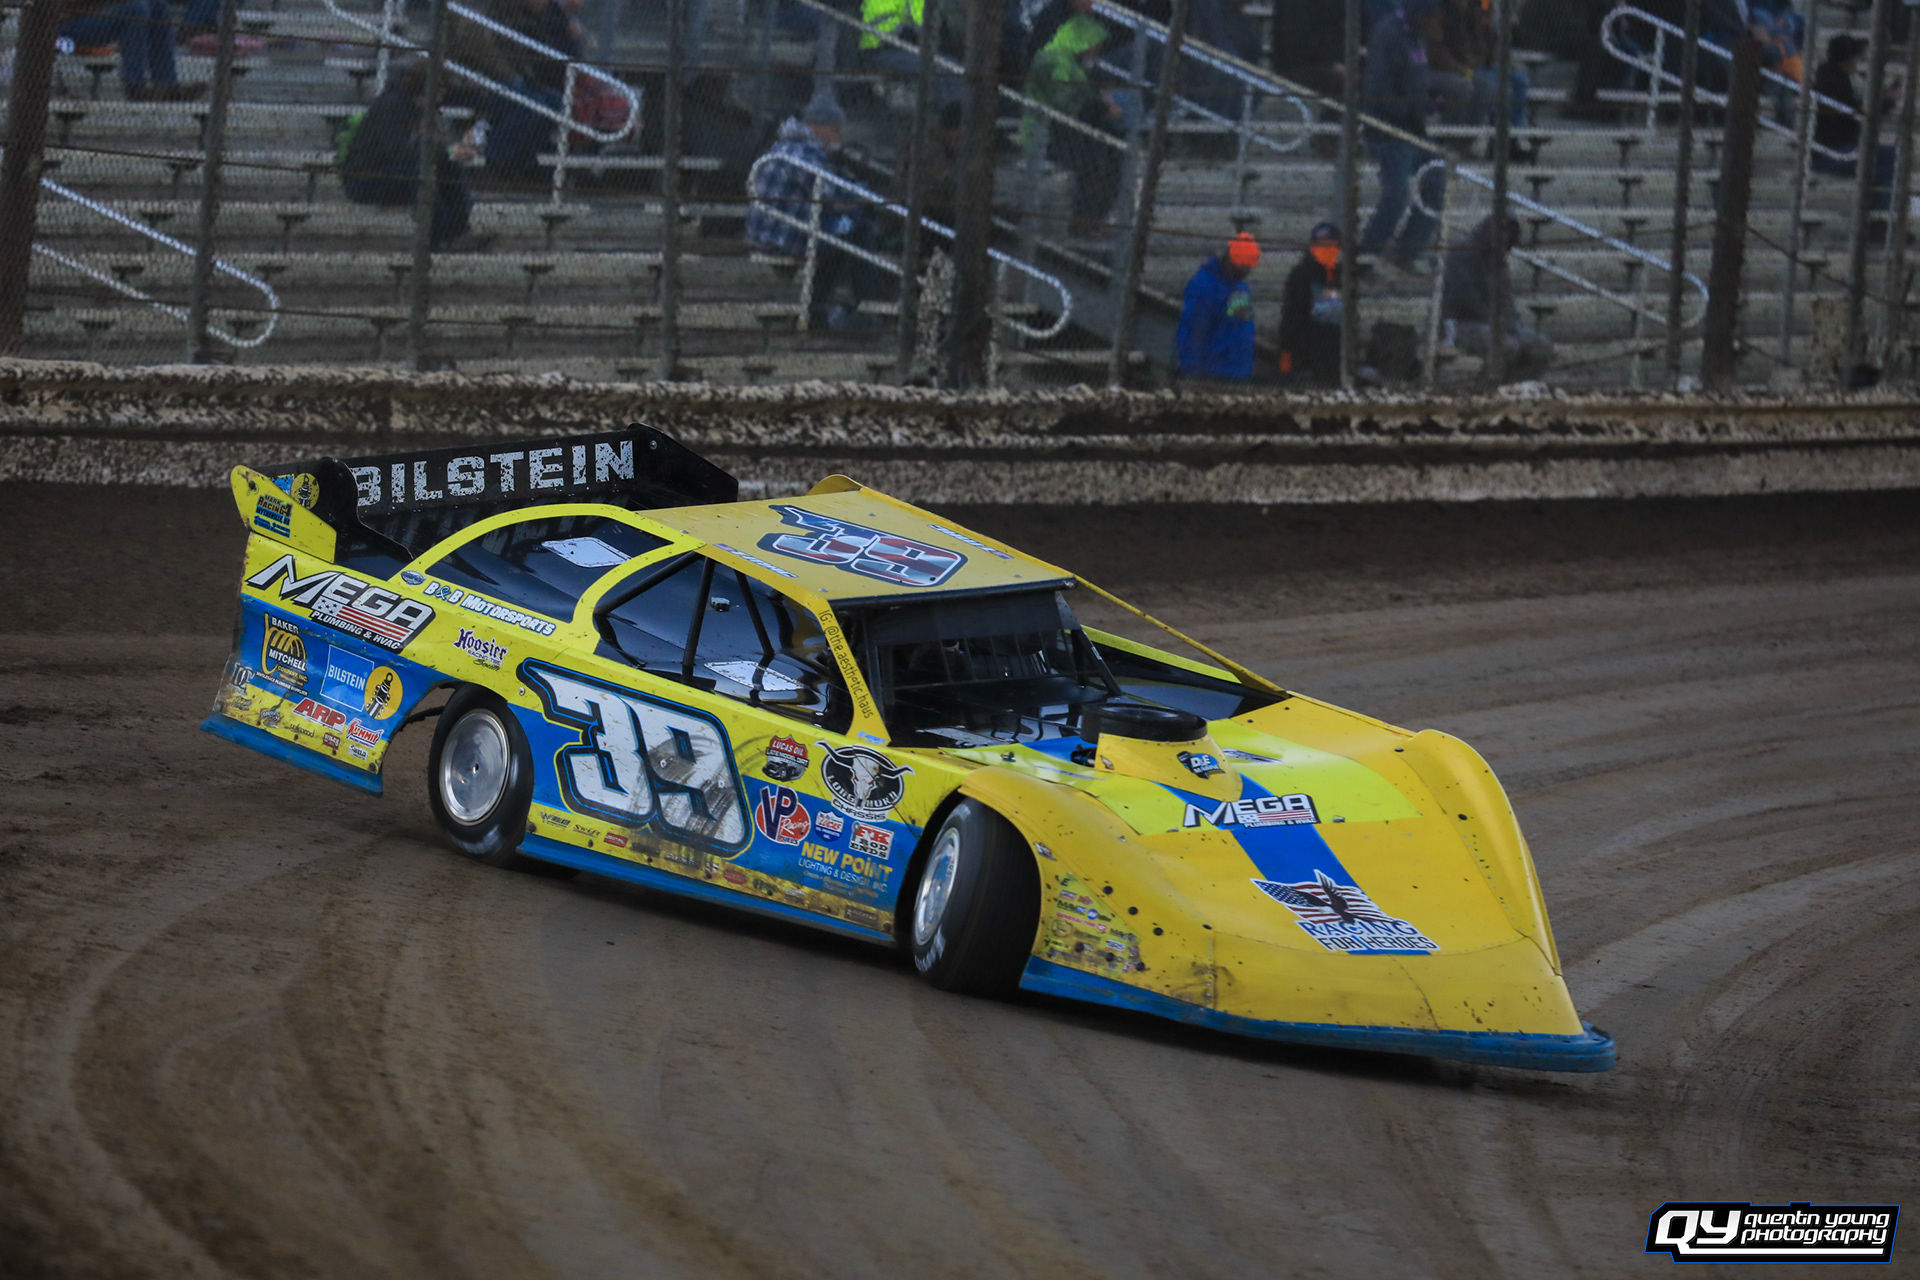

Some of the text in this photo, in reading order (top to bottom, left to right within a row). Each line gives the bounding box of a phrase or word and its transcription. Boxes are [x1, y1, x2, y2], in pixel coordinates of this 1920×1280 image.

[350, 440, 635, 508] BILSTEIN
[760, 505, 966, 586] 39
[246, 554, 434, 630] MEGA
[271, 617, 300, 633] BAKER
[460, 593, 556, 636] MOTORSPORTS
[819, 609, 834, 625] IG:
[310, 610, 401, 650] PLUMBING & HVAC
[452, 628, 509, 661] Hoosier
[467, 649, 490, 662] RACING
[269, 649, 307, 671] MITCHELL
[328, 664, 366, 691] BILSTEIN
[294, 699, 346, 728] ARP
[530, 664, 748, 848] 39
[772, 740, 805, 757] LUCAS OIL
[761, 784, 799, 840] VP
[831, 798, 887, 820] CHASSIS
[1183, 793, 1312, 827] MEGA
[574, 824, 601, 837] Swift
[779, 818, 810, 836] Racing
[818, 819, 843, 830] LUCAS
[1244, 819, 1287, 829] PLUMBING
[1296, 817, 1318, 825] HVAC
[801, 841, 841, 866] NEW
[850, 842, 887, 858] ENDS
[861, 839, 889, 852] ROD
[798, 857, 834, 876] LIGHTING
[832, 868, 840, 879] &
[1299, 918, 1418, 937] RACING
[1317, 935, 1438, 950] FOR HEROES
